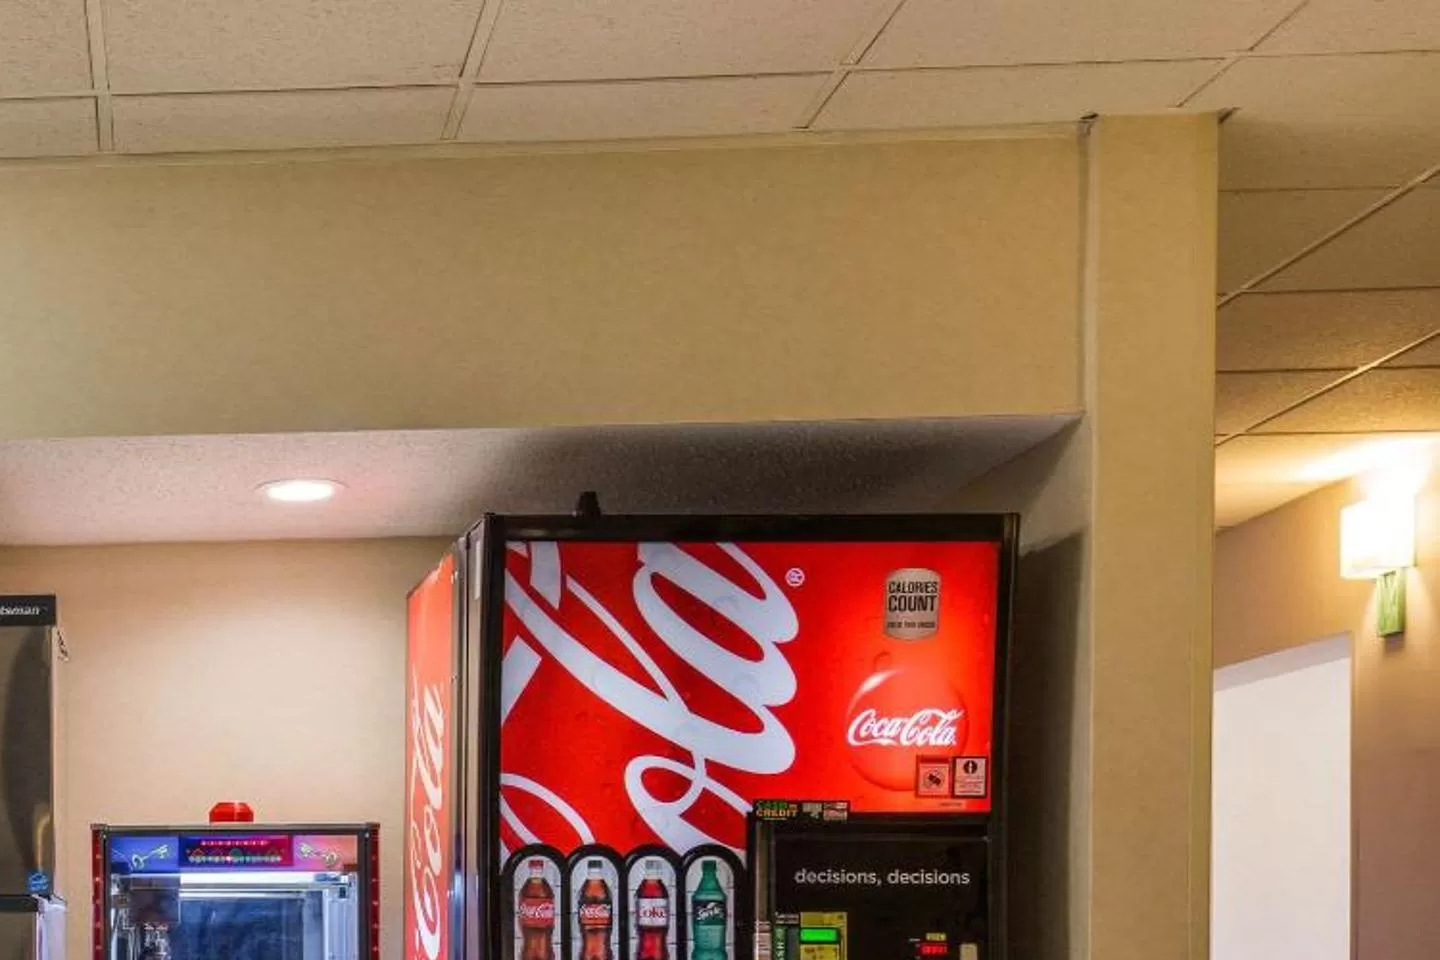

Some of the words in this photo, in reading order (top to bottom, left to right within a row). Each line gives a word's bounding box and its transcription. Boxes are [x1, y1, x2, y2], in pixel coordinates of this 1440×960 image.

[888, 581, 938, 594] CALORIES
[888, 595, 937, 613] COUNT
[756, 809, 797, 818] CREDIT
[794, 868, 882, 886] decisions,
[887, 868, 971, 885] decisions
